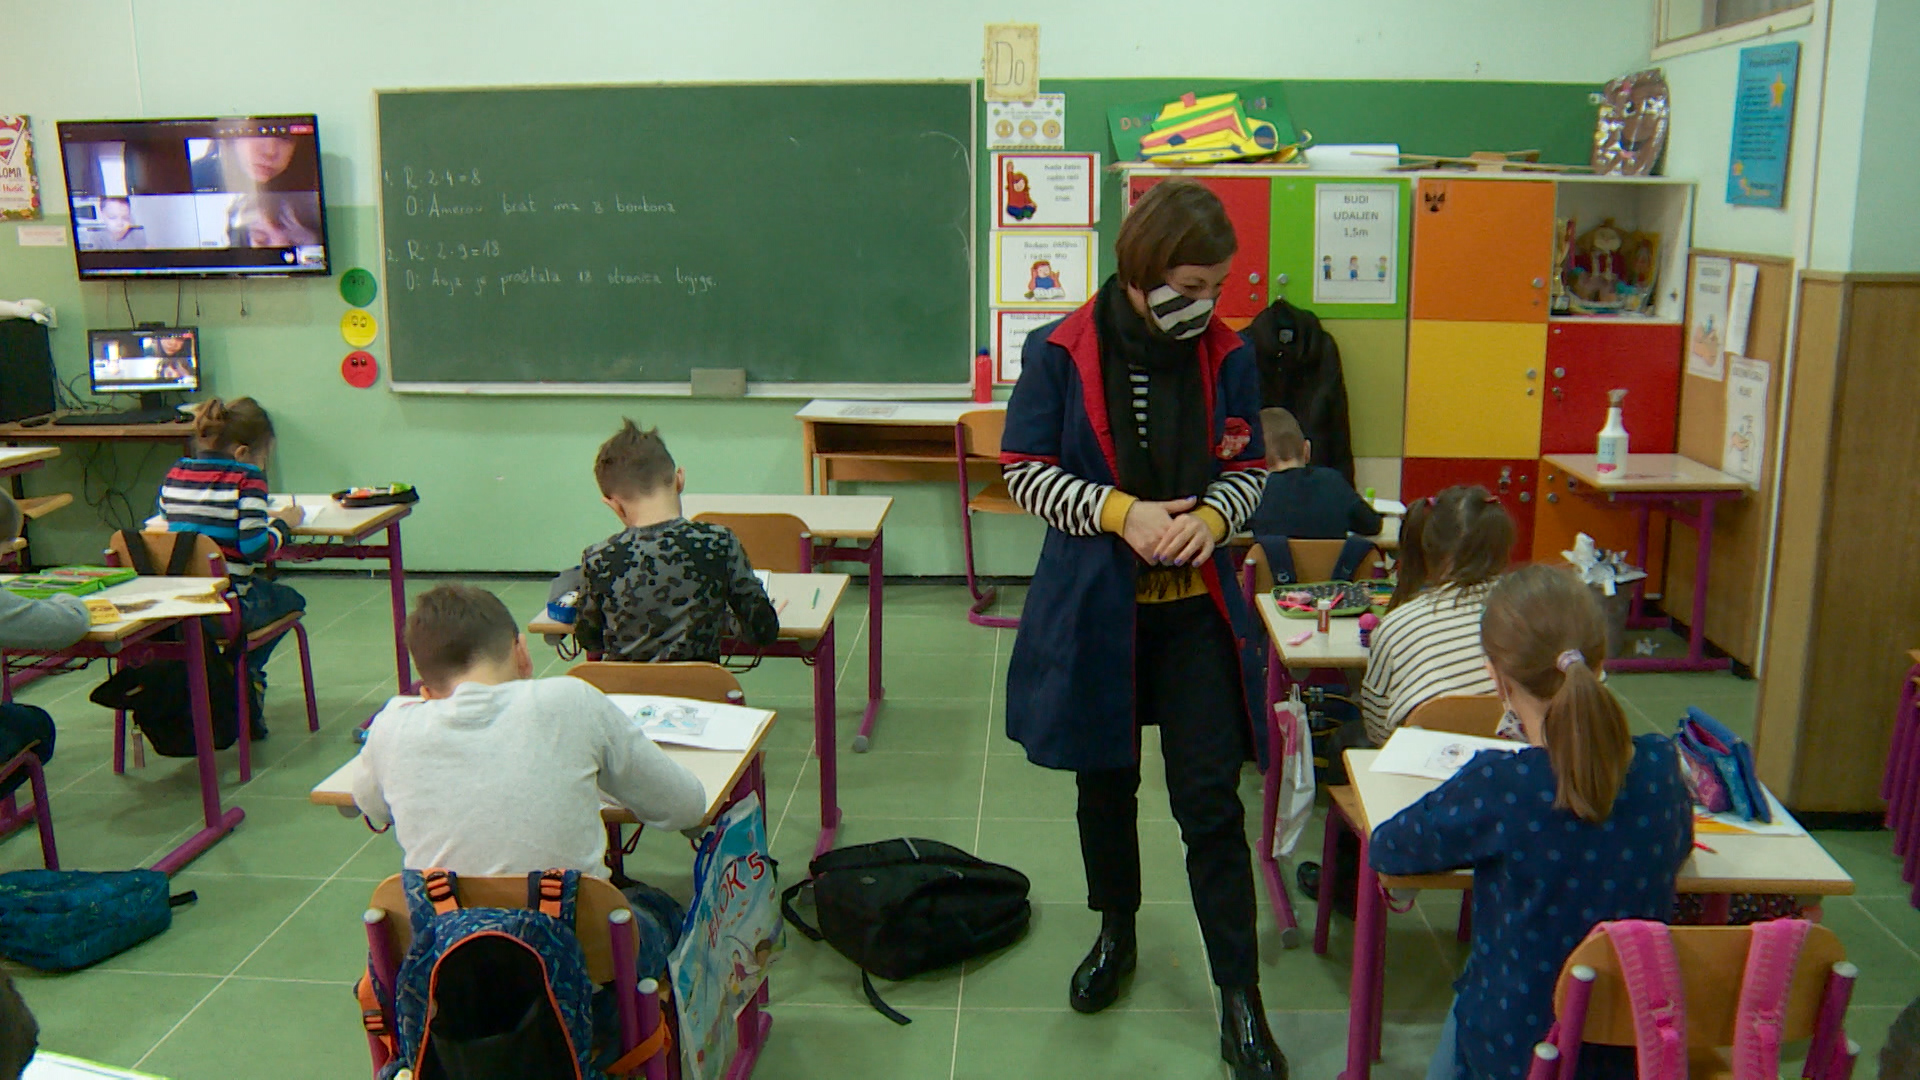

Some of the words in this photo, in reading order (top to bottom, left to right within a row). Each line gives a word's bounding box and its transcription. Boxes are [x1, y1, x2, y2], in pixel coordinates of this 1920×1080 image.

[992, 41, 1025, 86] Do
[1344, 195, 1369, 204] BUDI
[1333, 211, 1379, 220] UDALJEN
[745, 850, 766, 881] 5
